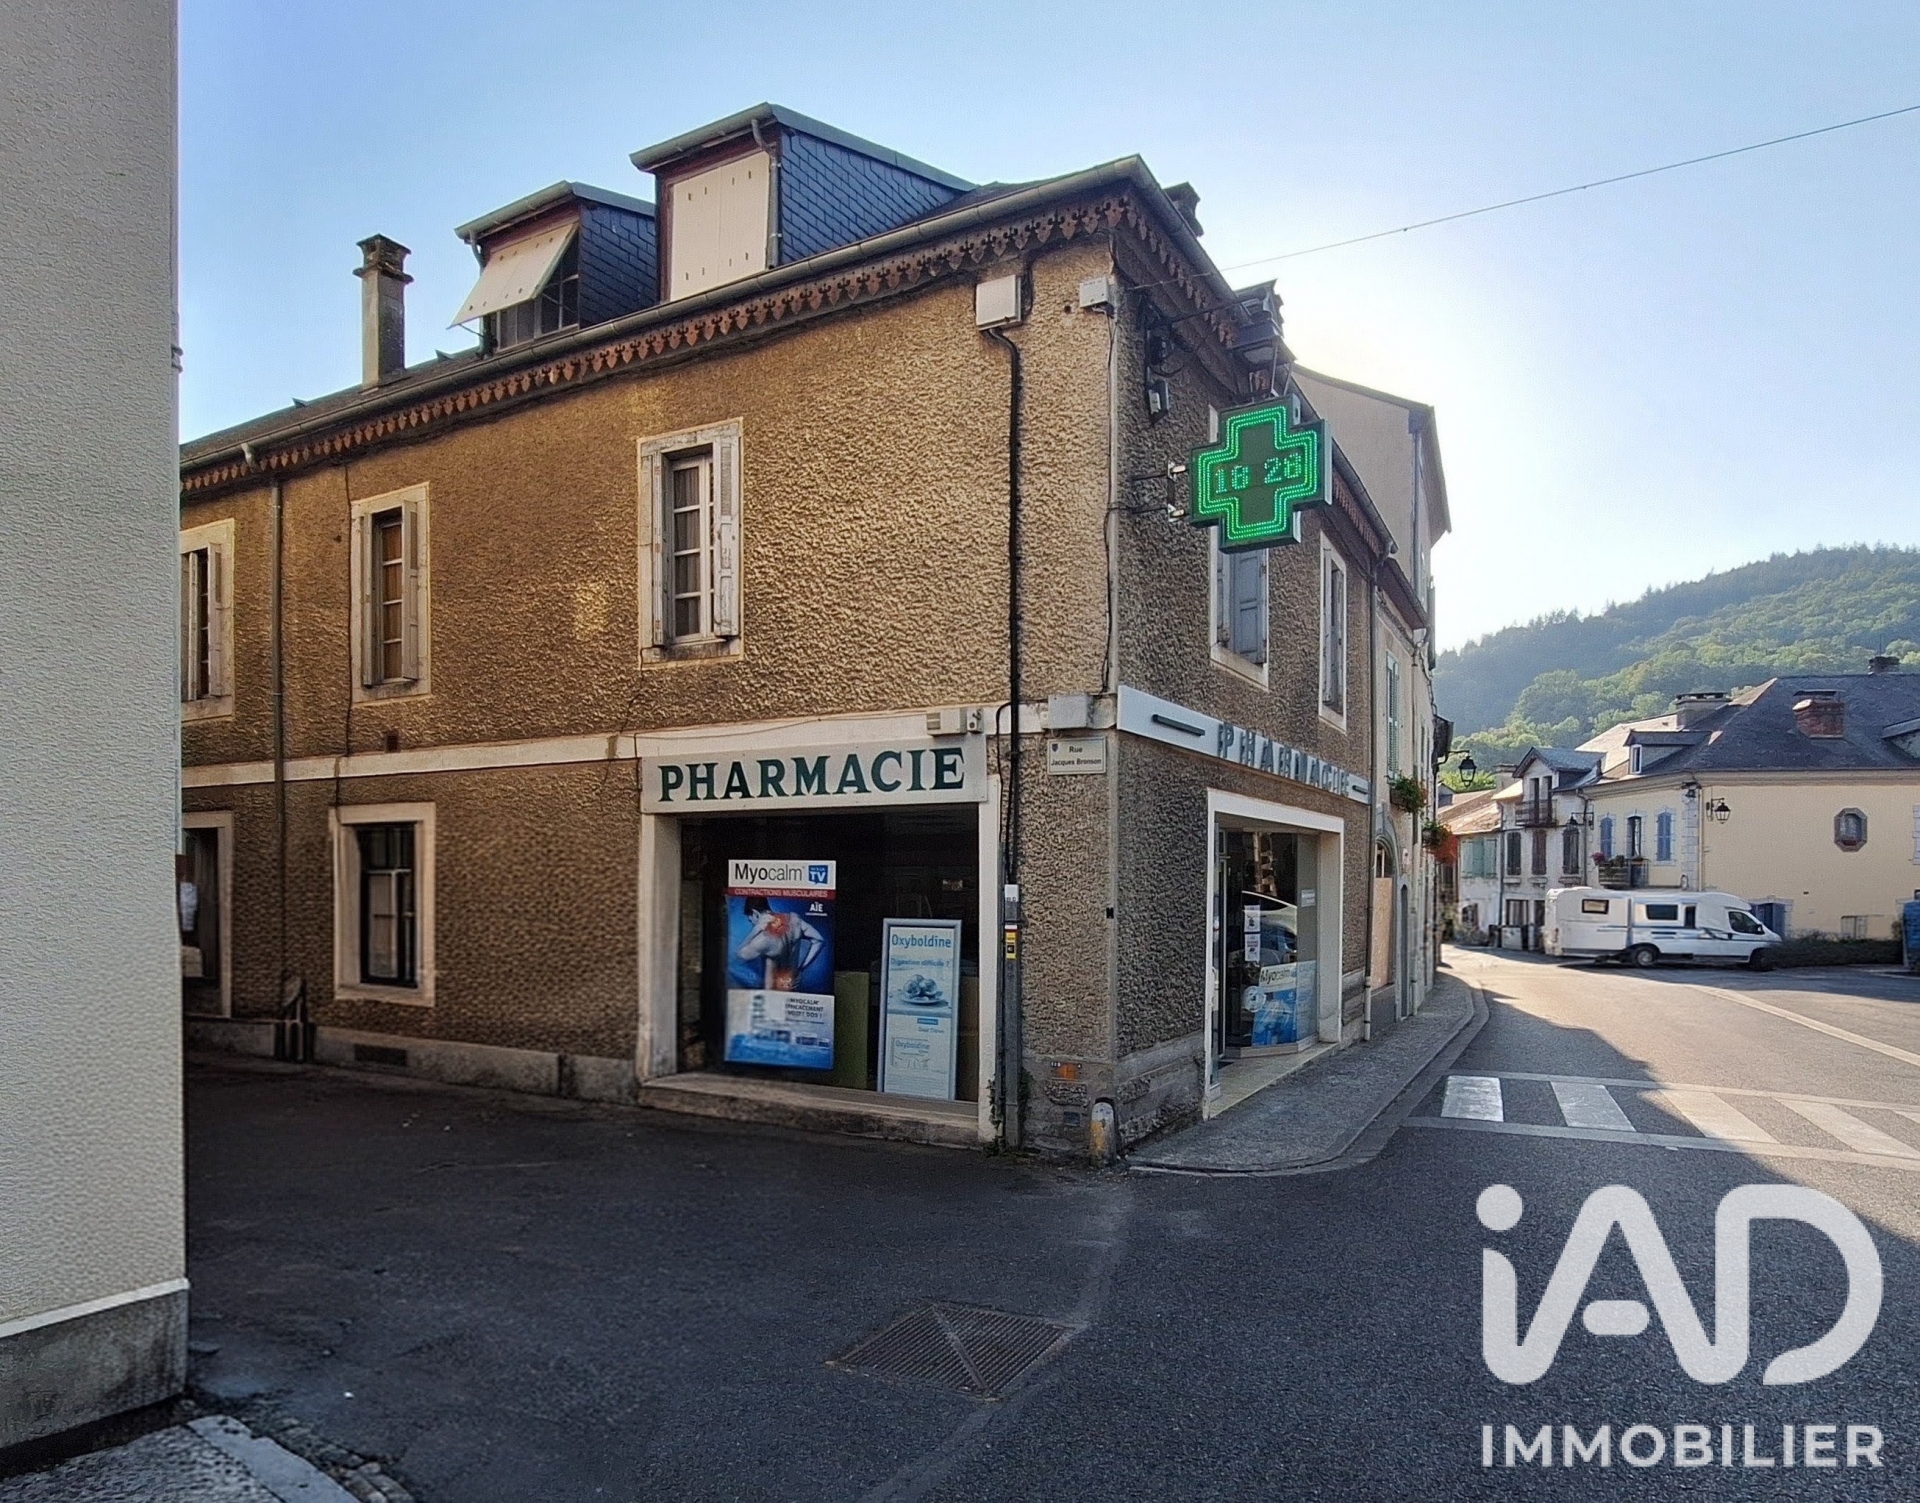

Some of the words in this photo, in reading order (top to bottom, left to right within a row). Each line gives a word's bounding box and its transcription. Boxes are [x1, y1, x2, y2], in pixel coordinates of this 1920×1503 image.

[1217, 721, 1349, 797] PHARMACIE
[658, 747, 965, 803] PHARMACIE
[735, 863, 803, 884] Myocalm
[809, 871, 826, 882] TV
[735, 888, 781, 897] CONTRACTIONS
[782, 889, 828, 898] MUSCULAIRES
[891, 934, 952, 949] Oxyboldine
